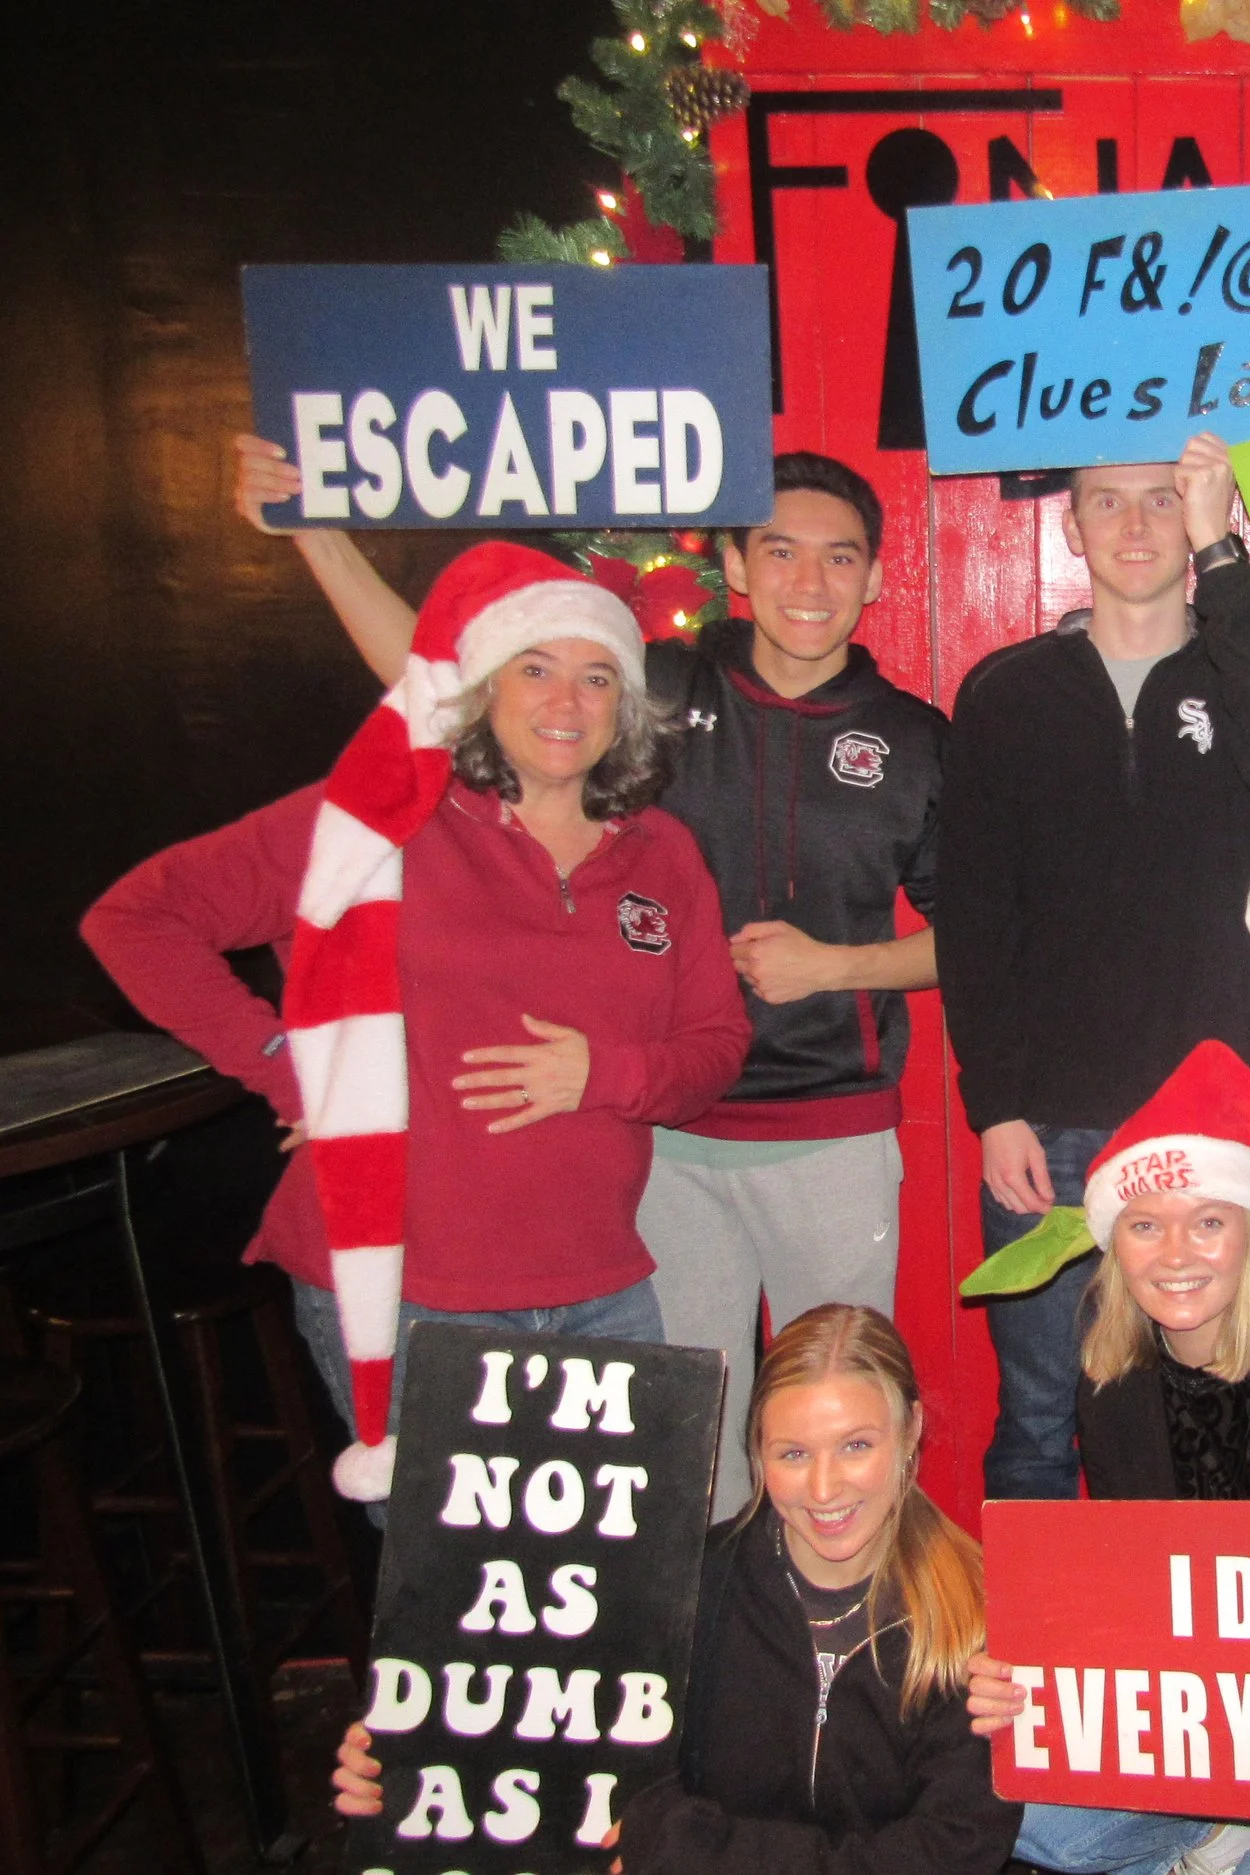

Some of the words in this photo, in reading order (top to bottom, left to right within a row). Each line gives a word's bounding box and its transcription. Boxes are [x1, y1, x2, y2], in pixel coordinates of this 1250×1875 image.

[946, 244, 1052, 319] 20
[449, 284, 558, 371] WE
[956, 352, 1168, 437] Clues
[292, 388, 724, 519] ESCAPED
[1117, 1168, 1200, 1202] WARS
[470, 1350, 636, 1434] I'M
[439, 1452, 649, 1538] NOT
[458, 1559, 600, 1639] AS
[1169, 1554, 1194, 1639] I
[361, 1657, 676, 1746] DUMB
[395, 1764, 542, 1844] AS
[574, 1772, 618, 1848] I
